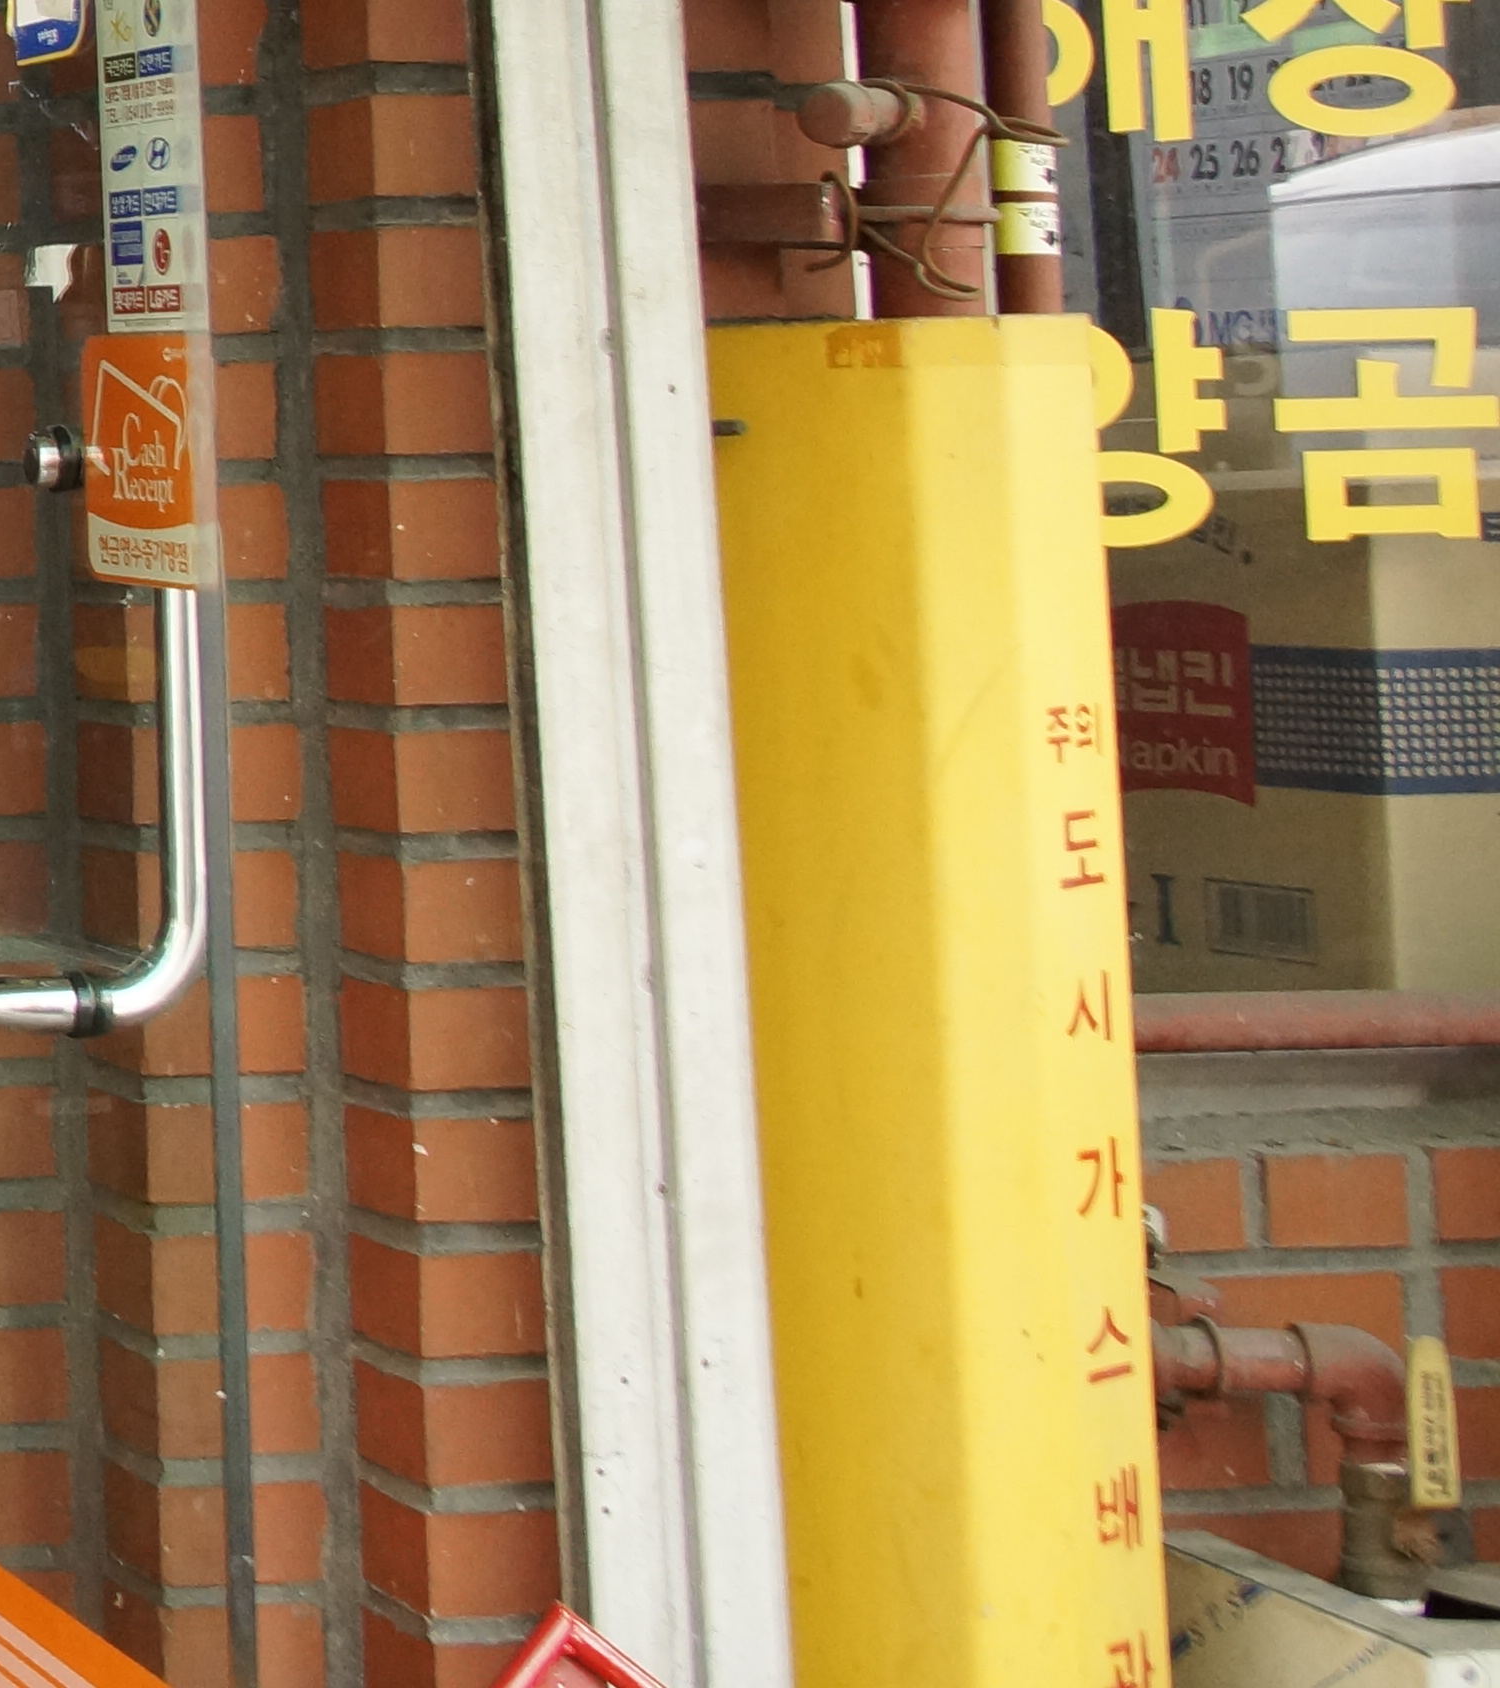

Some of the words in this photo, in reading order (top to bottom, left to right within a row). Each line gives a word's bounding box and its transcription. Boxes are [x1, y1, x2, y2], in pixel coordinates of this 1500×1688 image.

[1228, 64, 1254, 101] 19
[1152, 146, 1182, 184] 24
[1189, 142, 1220, 181] 25
[1230, 139, 1260, 178] 26
[122, 412, 167, 475] Cash
[110, 446, 176, 513] Receipt
[97, 533, 190, 575] 현금영수증가맹점
[1045, 701, 1101, 765] 주의
[1120, 731, 1239, 778] apkin
